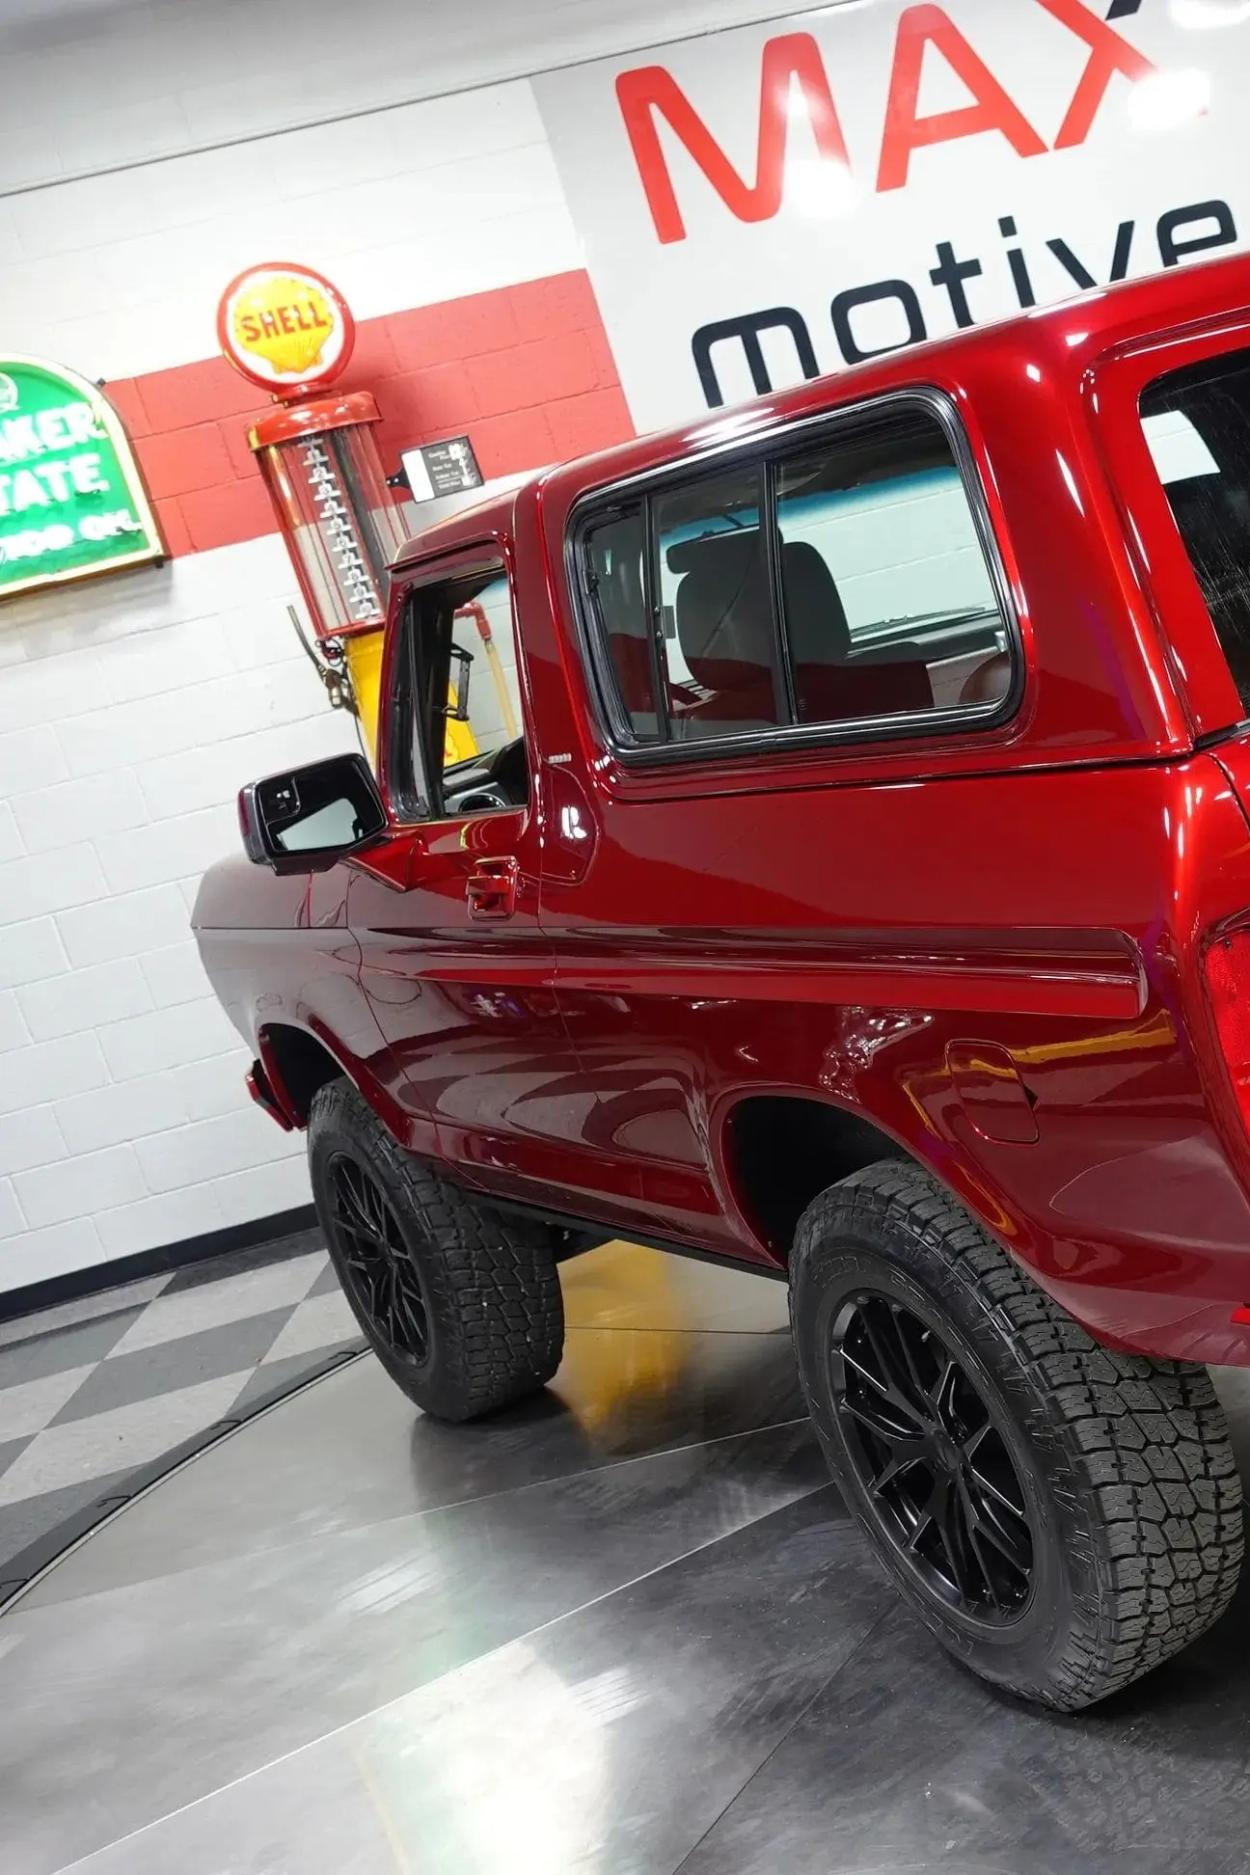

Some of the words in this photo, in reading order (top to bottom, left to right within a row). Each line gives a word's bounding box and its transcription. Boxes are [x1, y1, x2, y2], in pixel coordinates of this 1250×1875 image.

[615, 0, 1206, 244] MAX
[240, 301, 328, 342] SHELL
[691, 199, 1238, 408] motive
[0, 402, 108, 462] KER
